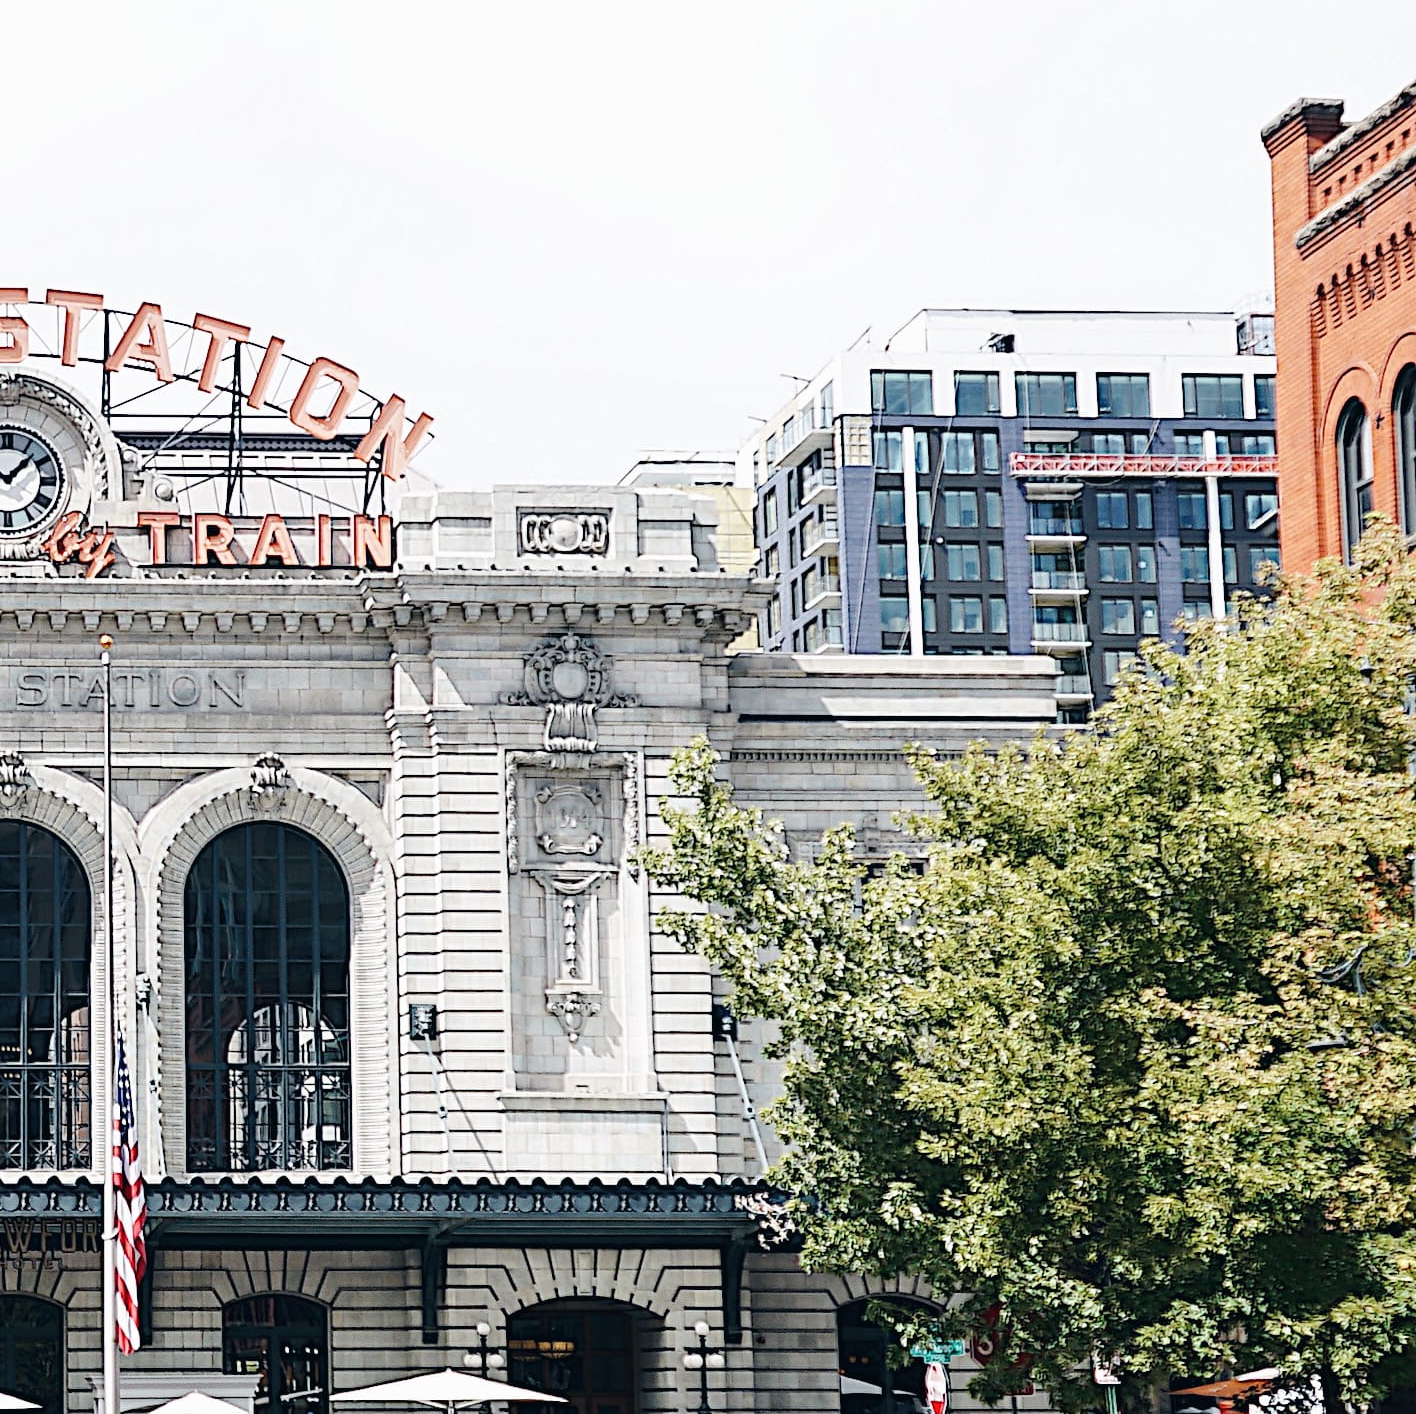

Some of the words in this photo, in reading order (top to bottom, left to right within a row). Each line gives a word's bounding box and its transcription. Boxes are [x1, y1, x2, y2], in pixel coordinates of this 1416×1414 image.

[41, 510, 115, 579] by
[137, 513, 393, 568] TRAIN
[16, 670, 246, 709] STATION
